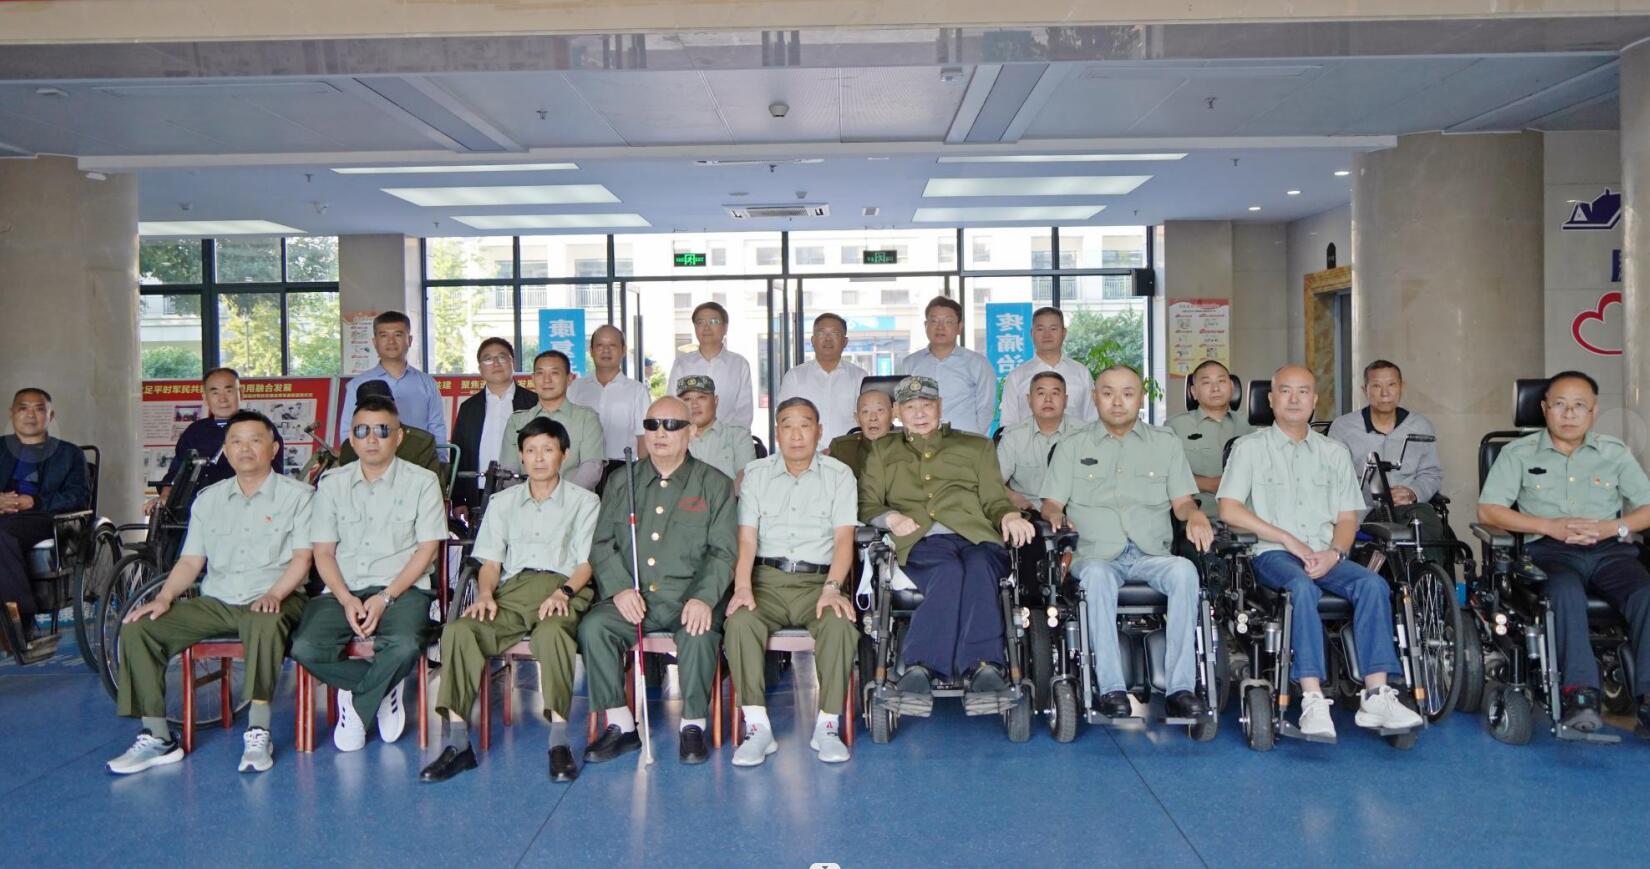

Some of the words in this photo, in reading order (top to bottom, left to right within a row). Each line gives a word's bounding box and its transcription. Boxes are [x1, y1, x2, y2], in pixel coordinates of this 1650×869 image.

[144, 384, 204, 395] 足平时军民共
